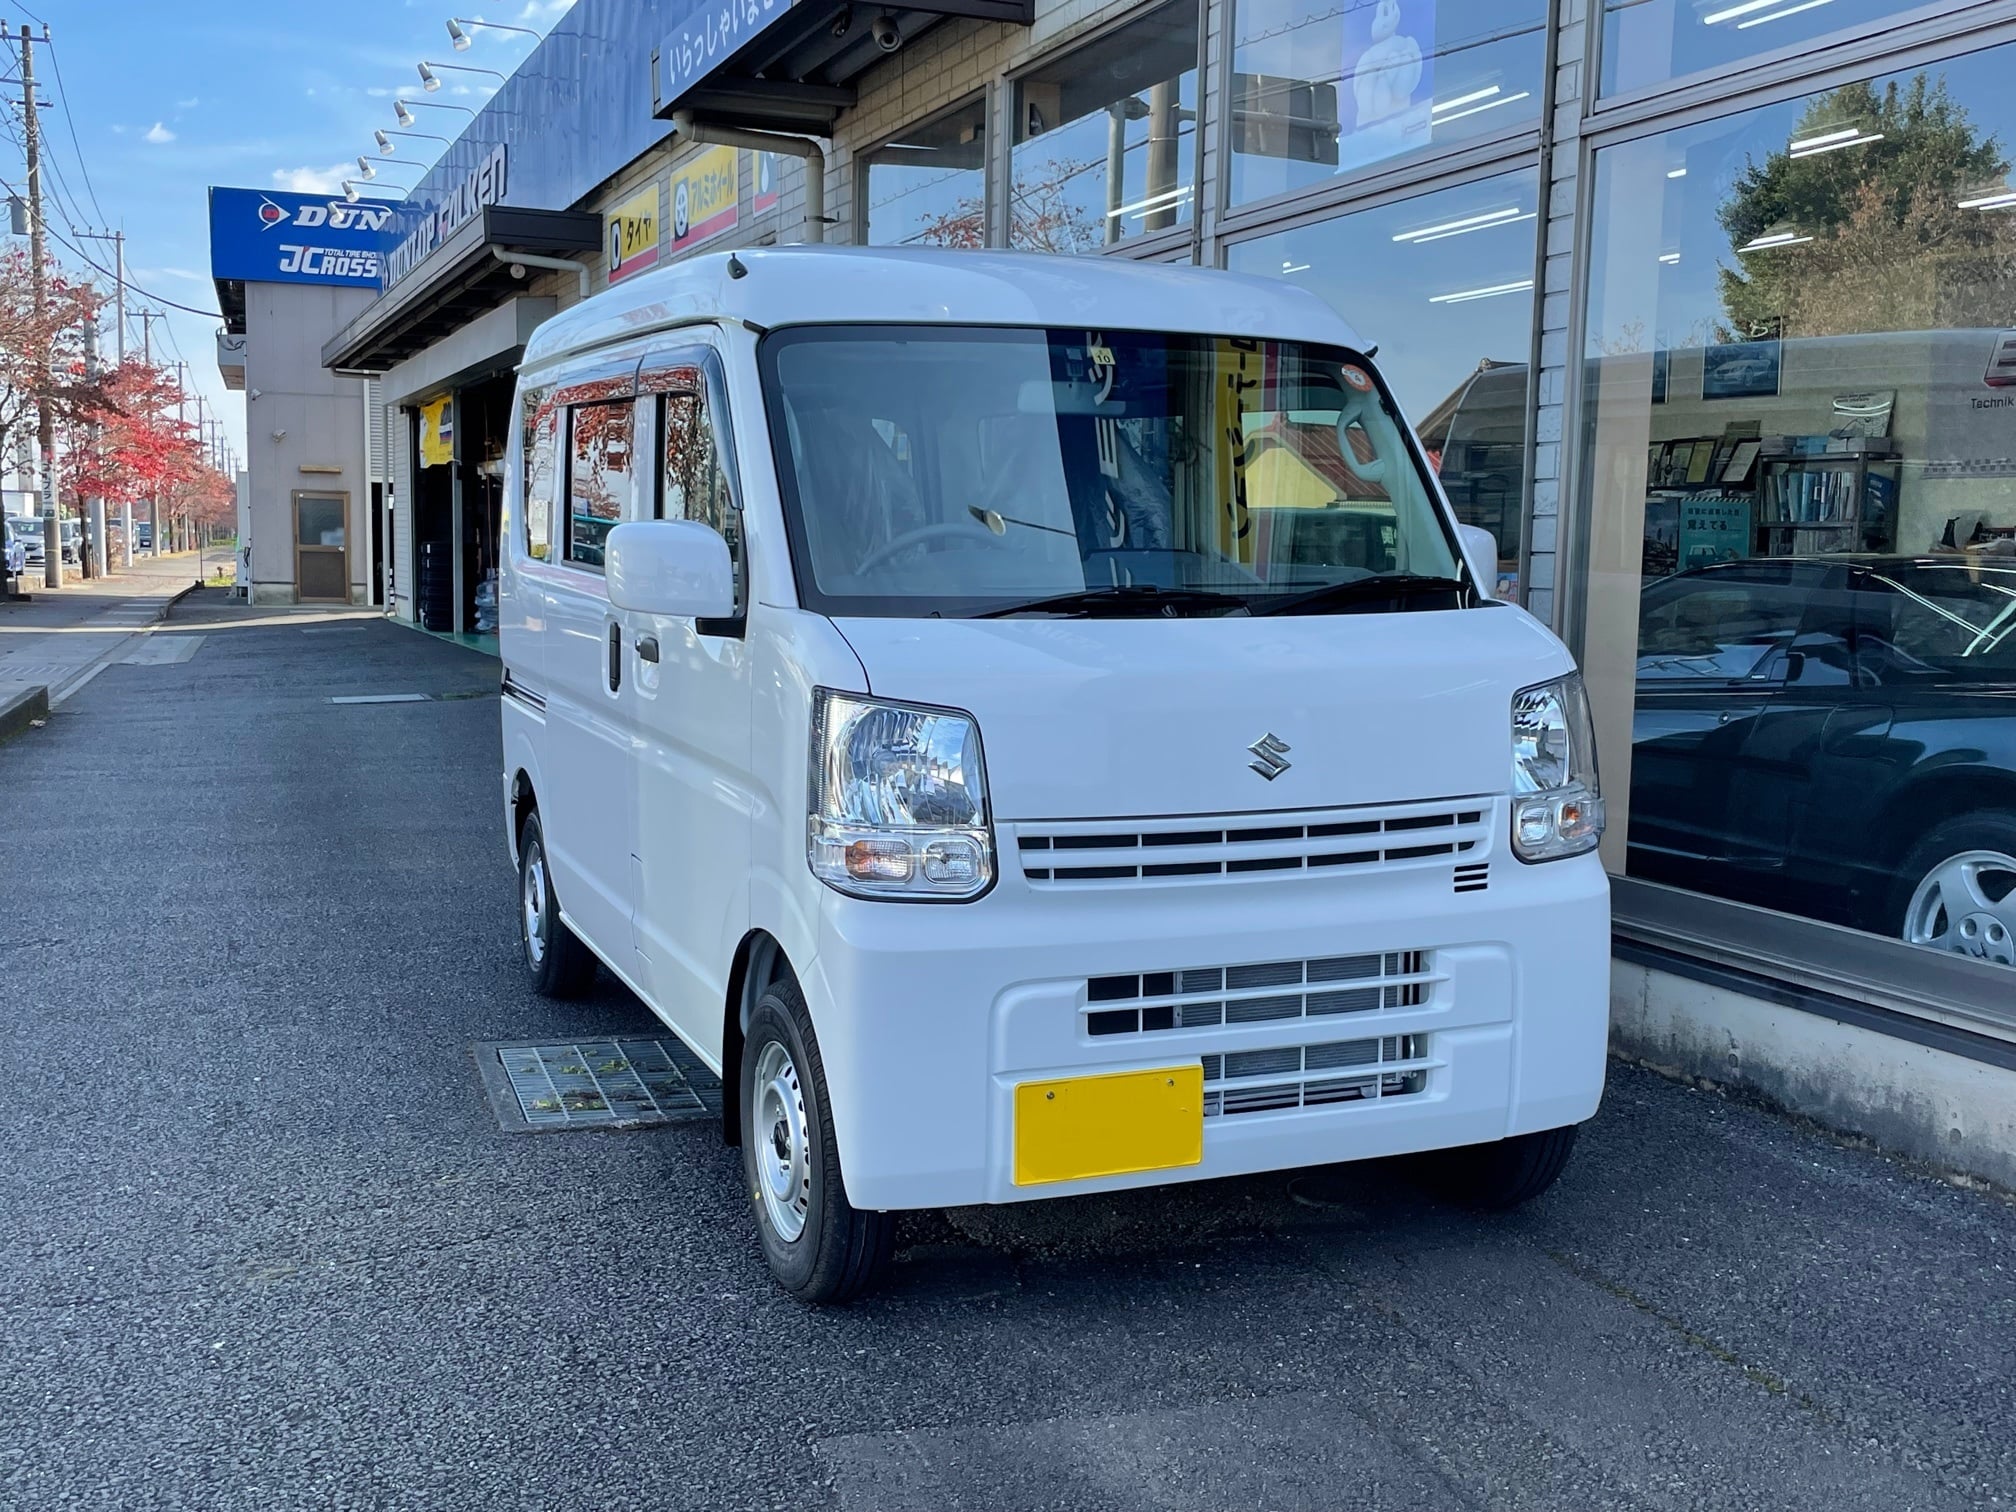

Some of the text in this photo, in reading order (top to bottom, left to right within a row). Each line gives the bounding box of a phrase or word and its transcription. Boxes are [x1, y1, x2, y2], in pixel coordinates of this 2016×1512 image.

[670, 0, 774, 85] いらっしゃいま
[626, 210, 652, 251] タイヤ
[1970, 397, 2015, 409] Technik
